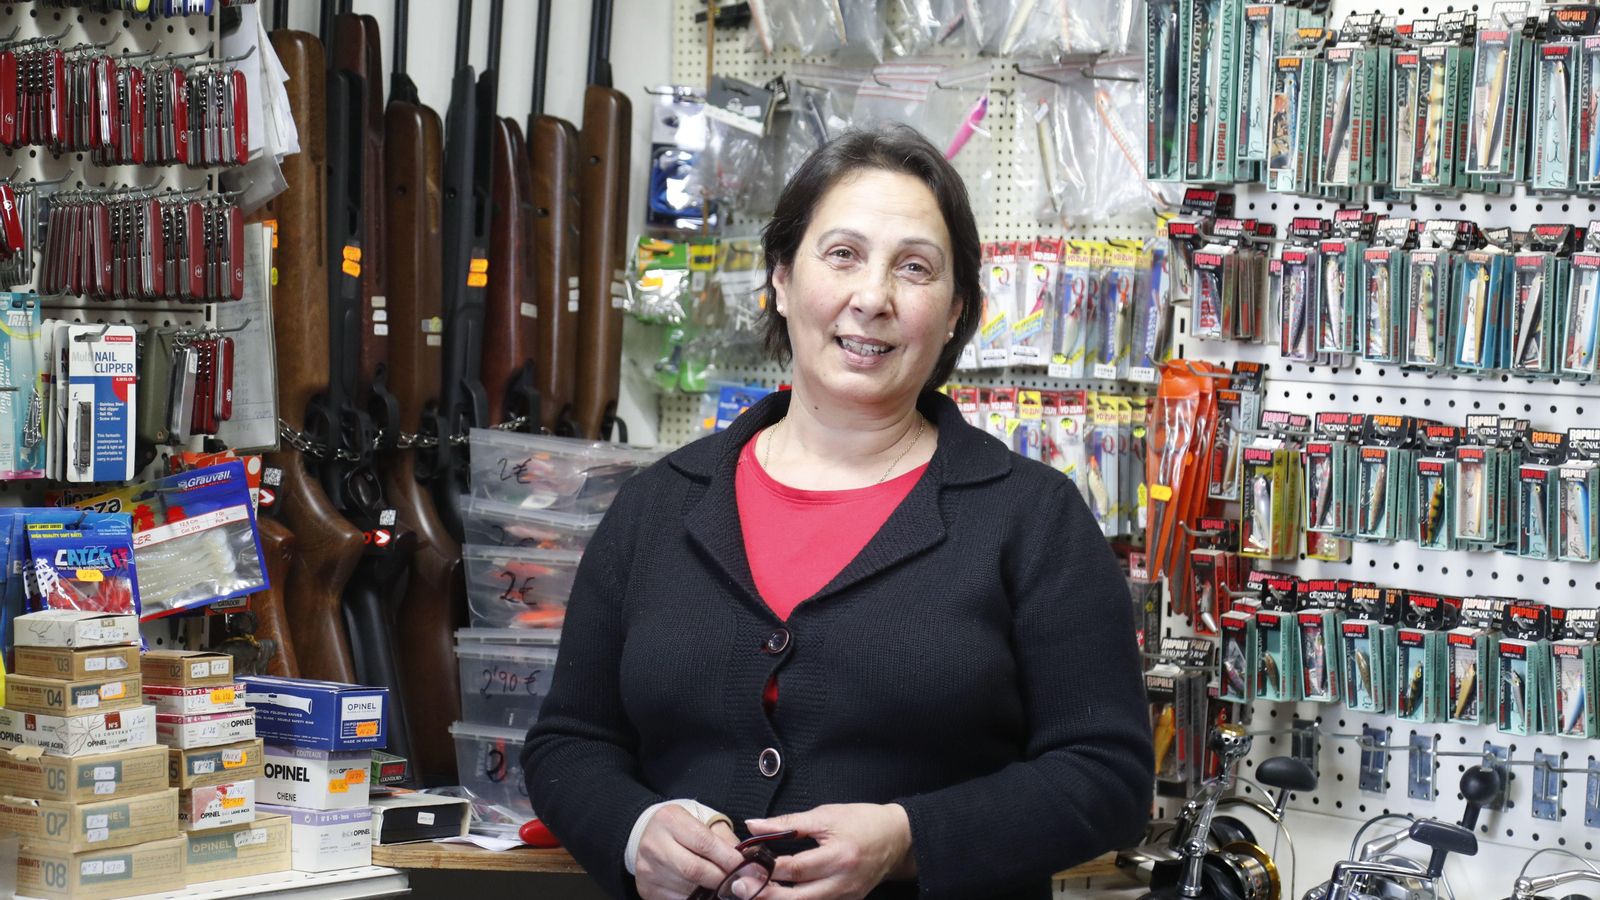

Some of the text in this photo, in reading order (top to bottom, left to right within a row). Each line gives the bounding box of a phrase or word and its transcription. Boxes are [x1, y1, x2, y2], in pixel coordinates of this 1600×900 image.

[1219, 62, 1230, 121] ORIGINAL
[1353, 52, 1363, 117] FLOATING
[1366, 61, 1375, 118] FLOATING
[1446, 59, 1457, 119] FLOATING
[1582, 57, 1590, 109] FLOATIN
[1326, 67, 1334, 118] FLOATIN
[95, 351, 117, 362] NAIL
[94, 363, 133, 373] CLIPPER
[1468, 427, 1497, 435] FLATING
[187, 470, 232, 488] Grauvell
[46, 690, 62, 707] 04
[347, 703, 377, 711] OPINEL
[230, 719, 253, 728] OPINEL
[0, 731, 24, 744] OPINEL
[87, 739, 107, 748] OPINEL
[47, 767, 66, 791] 06
[264, 763, 310, 783] OPINEL
[277, 791, 297, 802] CHENE
[200, 810, 220, 819] OPINEL
[46, 811, 68, 836] 07
[353, 828, 370, 837] OPINEL
[192, 840, 232, 853] OPINEL
[45, 862, 67, 889] 08
